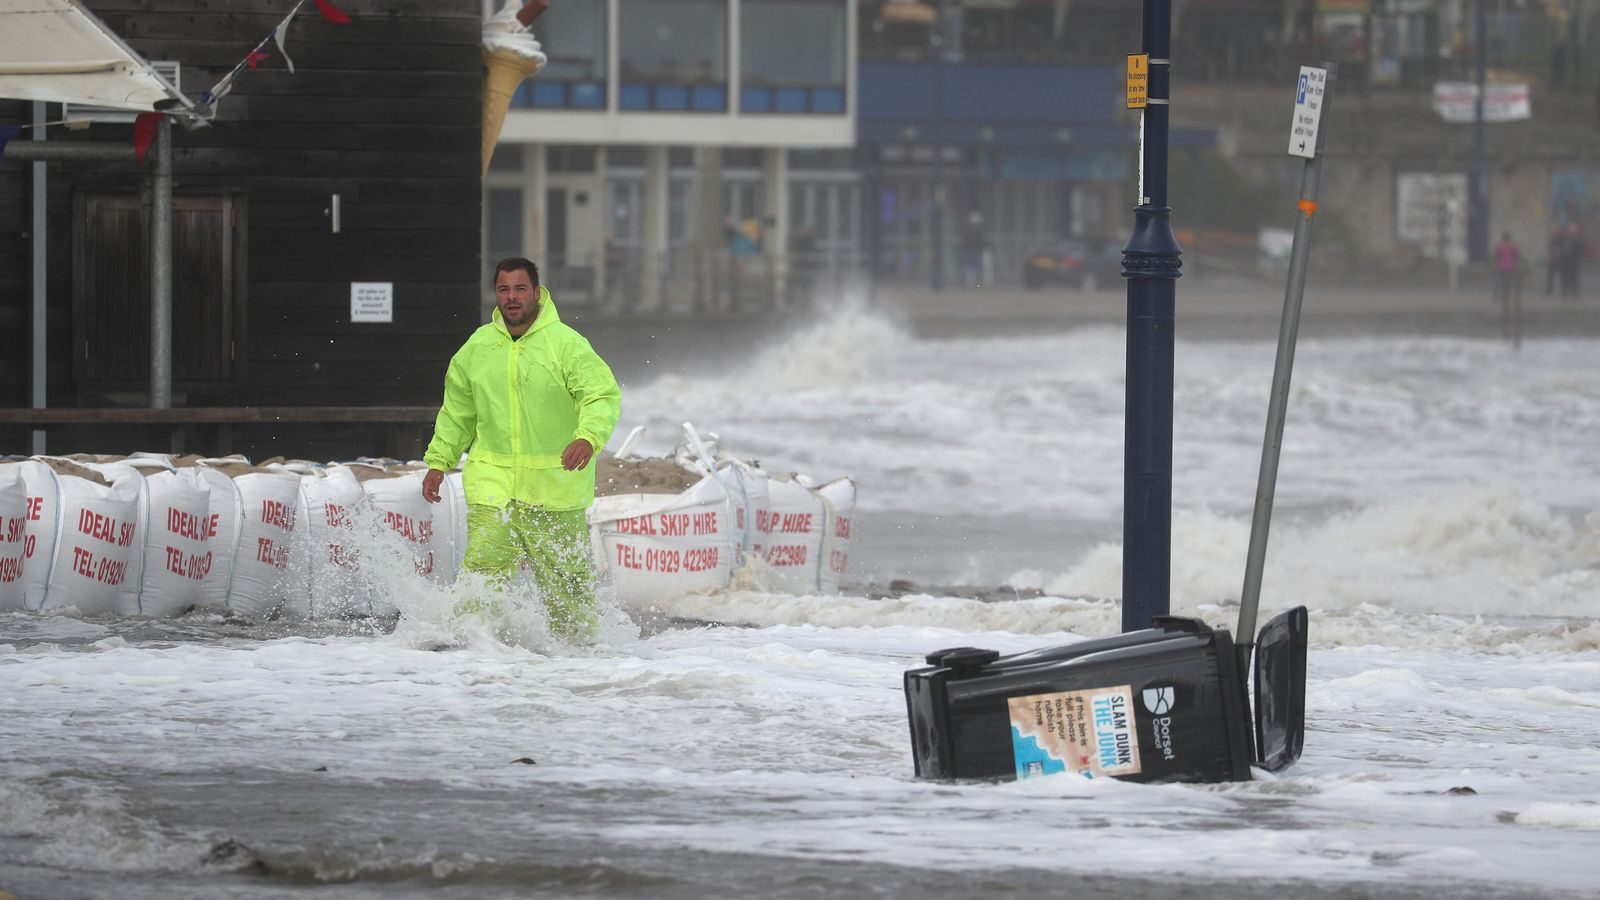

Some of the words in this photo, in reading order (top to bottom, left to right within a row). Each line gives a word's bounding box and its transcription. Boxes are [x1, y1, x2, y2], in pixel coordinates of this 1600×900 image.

[78, 508, 116, 544] IDEAL
[167, 507, 199, 541] IDEAL
[616, 514, 657, 535] IDEAL
[661, 513, 689, 536] SKIP
[694, 512, 717, 535] HIRE
[781, 512, 812, 533] HIRE
[73, 546, 97, 579] TEL:
[166, 545, 187, 577] TEL:
[616, 543, 642, 569] TEL:
[646, 548, 680, 573] 01929
[683, 547, 718, 572] 422980
[1034, 700, 1043, 726] home
[1045, 700, 1055, 733] rubbish
[1055, 699, 1064, 718] take
[1066, 697, 1074, 711] full
[1077, 704, 1085, 720] this
[1094, 698, 1112, 728] THE
[1111, 696, 1127, 729] SLAM
[1056, 720, 1066, 740] your
[1065, 713, 1076, 742] please
[1078, 723, 1086, 737] bin
[1080, 738, 1088, 746] is
[1152, 718, 1161, 749] Council
[1160, 717, 1175, 760] Dorset
[1097, 731, 1117, 768] JUNK
[1116, 733, 1131, 765] DUNK
